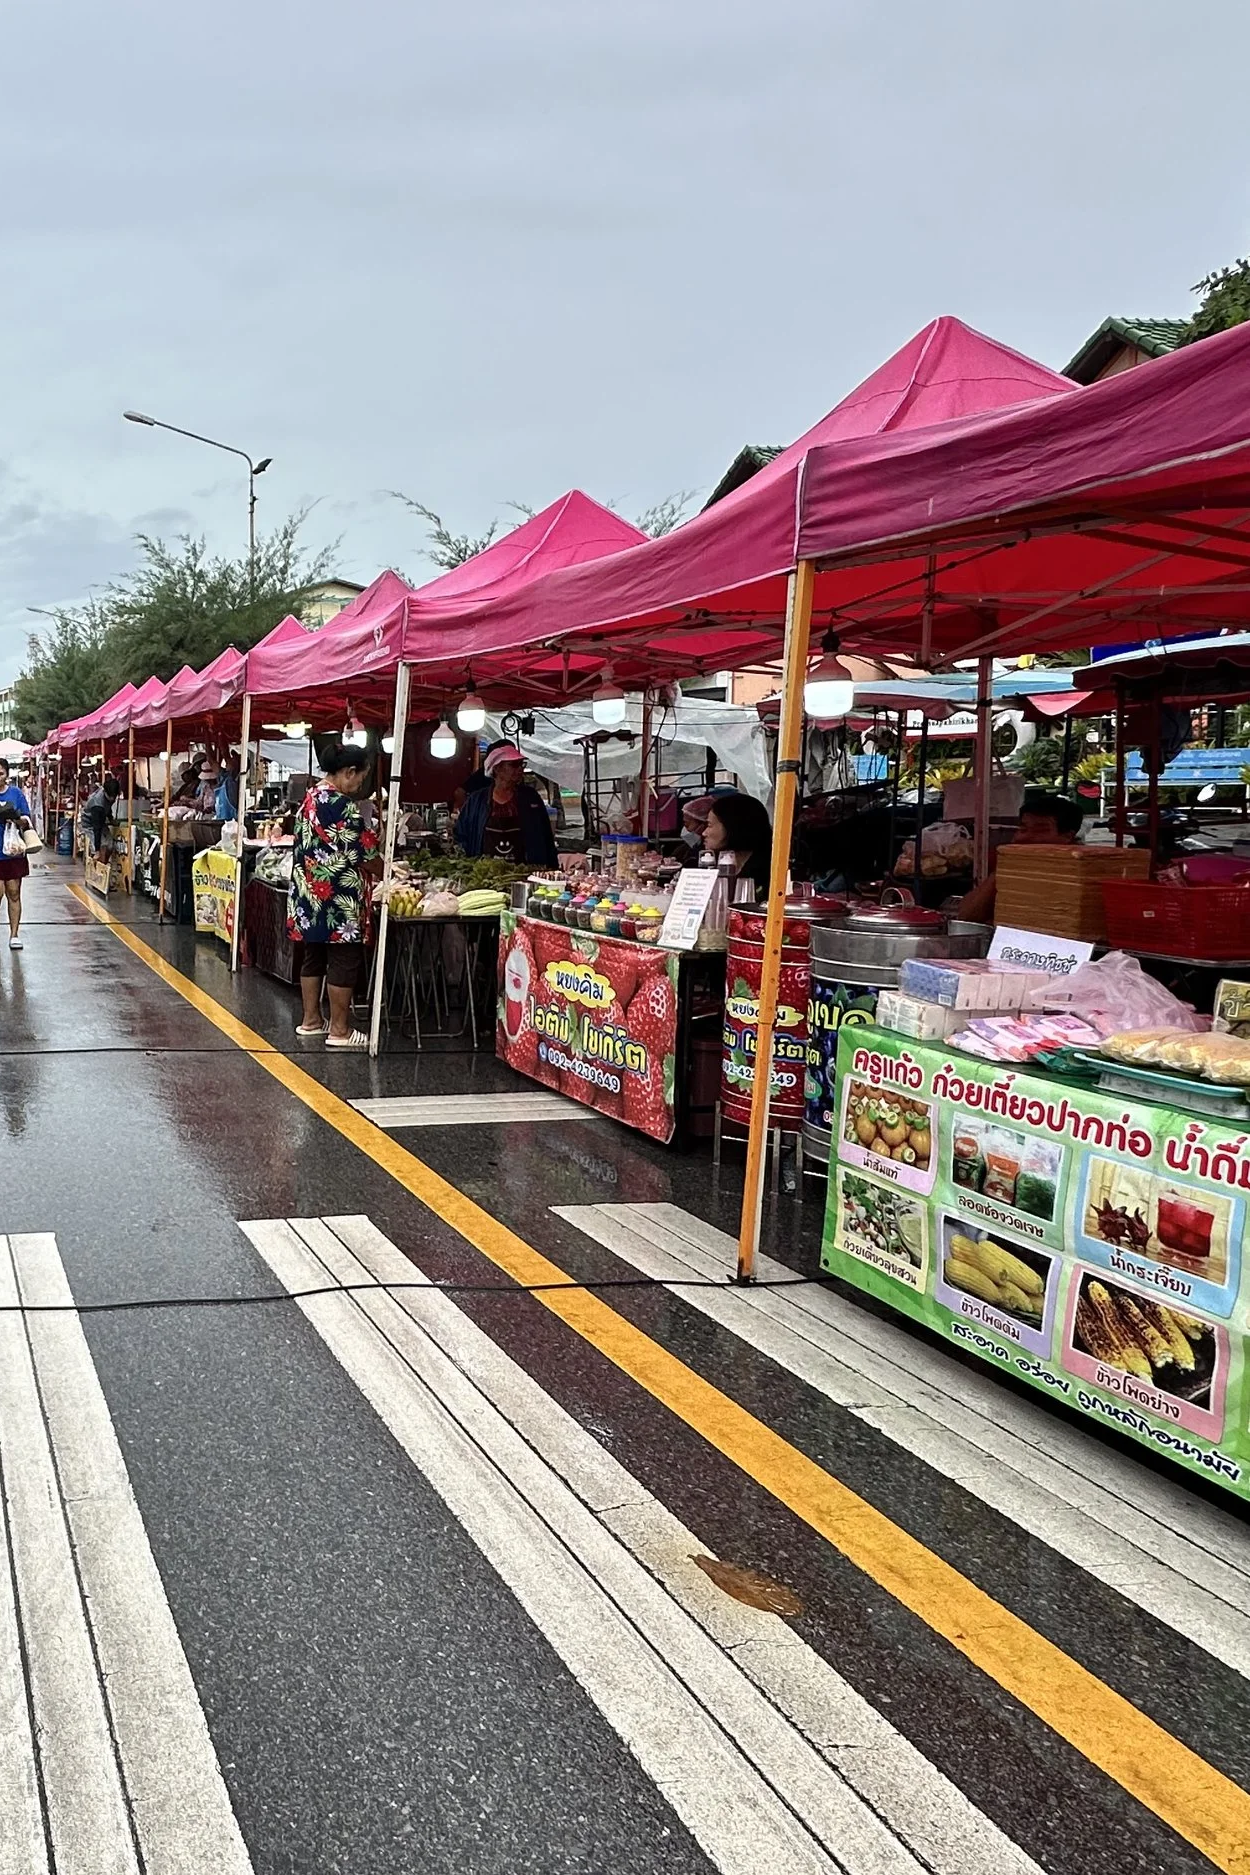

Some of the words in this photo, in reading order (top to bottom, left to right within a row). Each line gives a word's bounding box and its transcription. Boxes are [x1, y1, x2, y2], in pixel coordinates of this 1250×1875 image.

[528, 996, 570, 1044] ไอติม
[582, 1015, 648, 1075] โยเกิร์ต
[548, 1048, 620, 1093] 092-4239649
[854, 1047, 923, 1089] ครูแก้ว
[932, 1066, 1153, 1158] ก๋วยเตี๋ยวปากท่อ
[862, 1151, 902, 1180] น้ำส้มแท้
[843, 1236, 917, 1286] ก๋วยเตี๋ยวลุยสวน
[1110, 1249, 1191, 1297] น้ำกระเจี๊ยบ
[961, 1297, 1021, 1341] ข้าวโพดต้ม
[952, 1323, 1009, 1360] สะอาด
[1016, 1361, 1070, 1393] อร่อย
[1077, 1390, 1240, 1482] ถูกหลักอนามัย
[1096, 1366, 1180, 1419] ข้าวโพดย่าง
